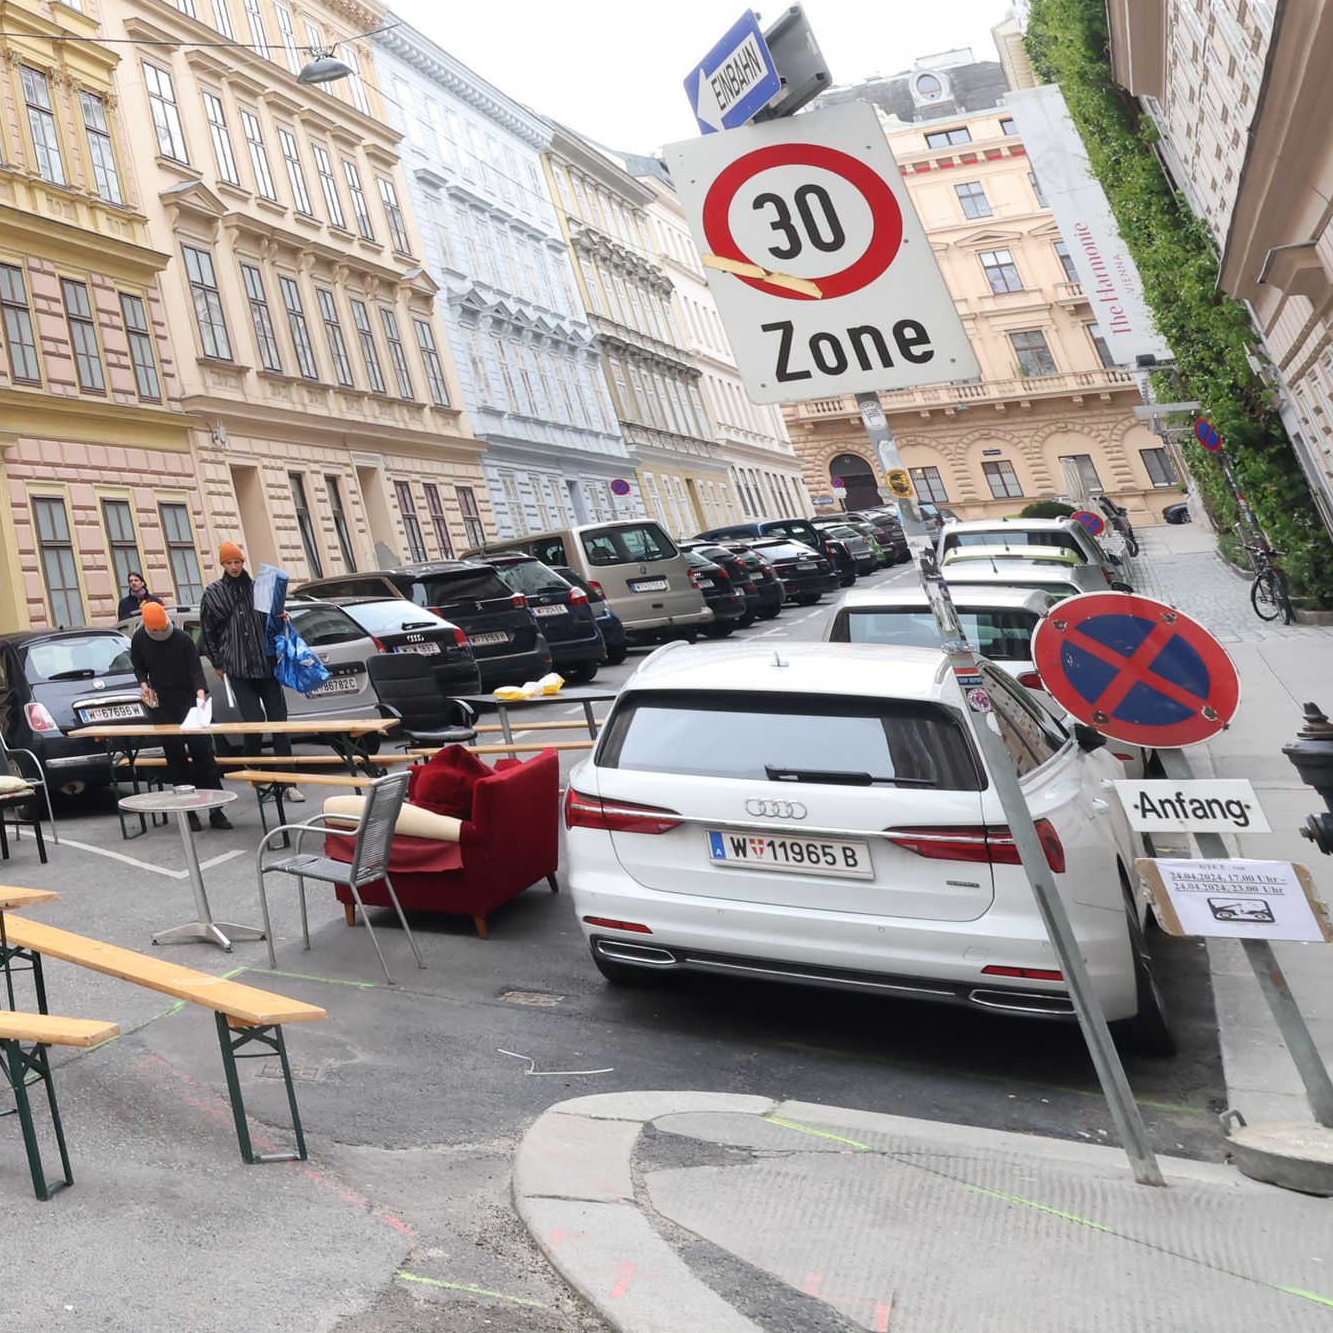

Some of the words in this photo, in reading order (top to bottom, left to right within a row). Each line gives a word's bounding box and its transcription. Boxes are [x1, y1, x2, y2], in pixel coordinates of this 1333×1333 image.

[711, 41, 763, 110] EINBAHN
[752, 183, 845, 260] 30
[1074, 222, 1119, 302] Harmonie
[1113, 253, 1135, 294] VIENNA
[1109, 306, 1132, 336] The
[760, 318, 934, 383] Zone
[1139, 791, 1250, 827] Anfang
[730, 836, 747, 859] W
[767, 840, 837, 866] 11965
[844, 846, 859, 868] B
[1257, 875, 1279, 883] Uhr
[1263, 885, 1284, 895] Uhr
